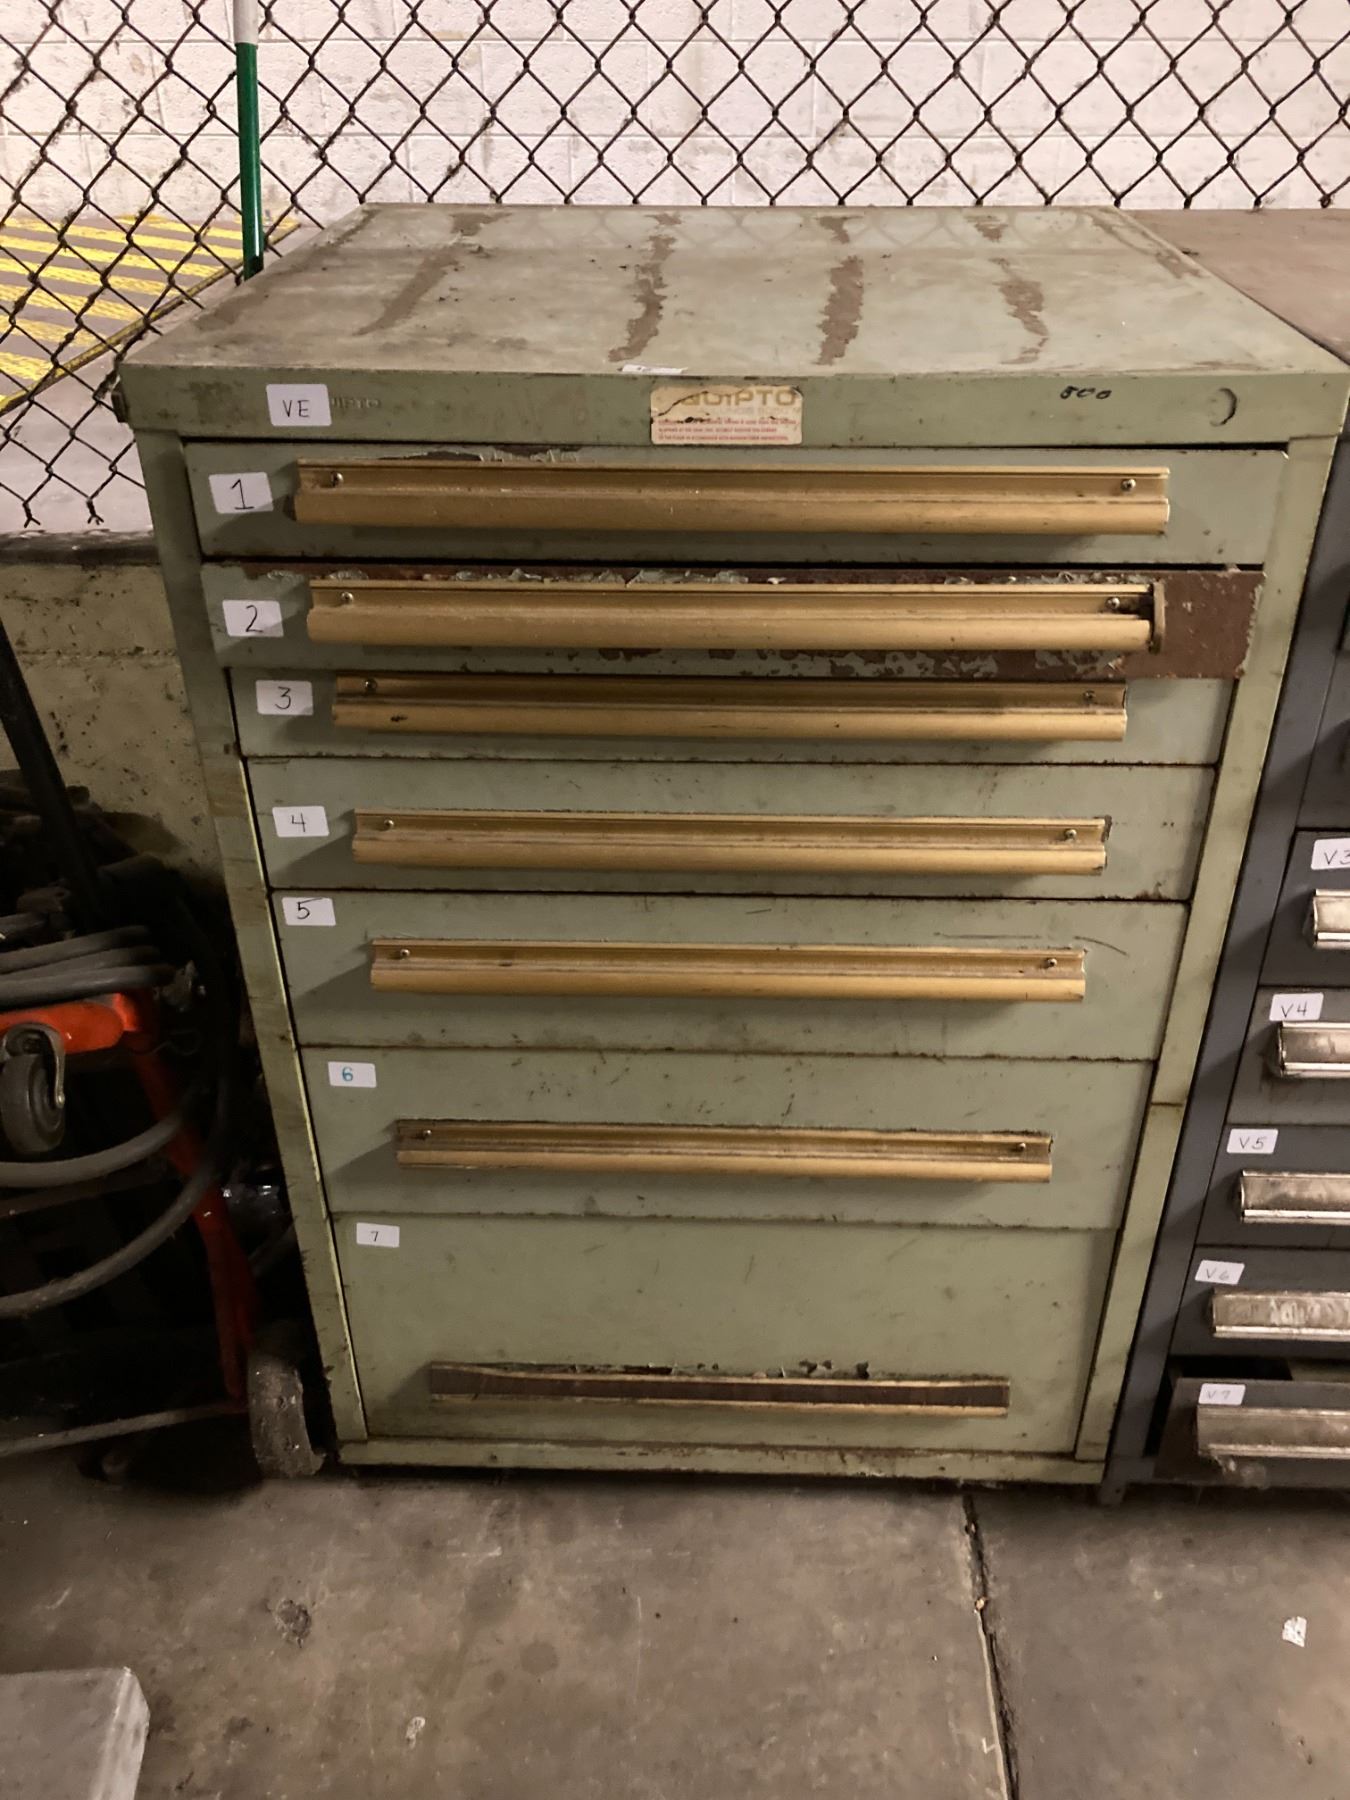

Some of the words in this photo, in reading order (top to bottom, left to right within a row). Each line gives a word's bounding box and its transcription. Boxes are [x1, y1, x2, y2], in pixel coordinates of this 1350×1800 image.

[282, 399, 309, 418] VE
[231, 478, 255, 510] 1
[246, 604, 264, 633] 2
[275, 686, 292, 711] 3
[290, 812, 307, 833] 4
[297, 897, 324, 920] 5
[1280, 1001, 1309, 1019] V4
[342, 1067, 354, 1083] 6
[1239, 1136, 1266, 1150] V5
[371, 1230, 380, 1242] 7
[1206, 1267, 1230, 1281] V6
